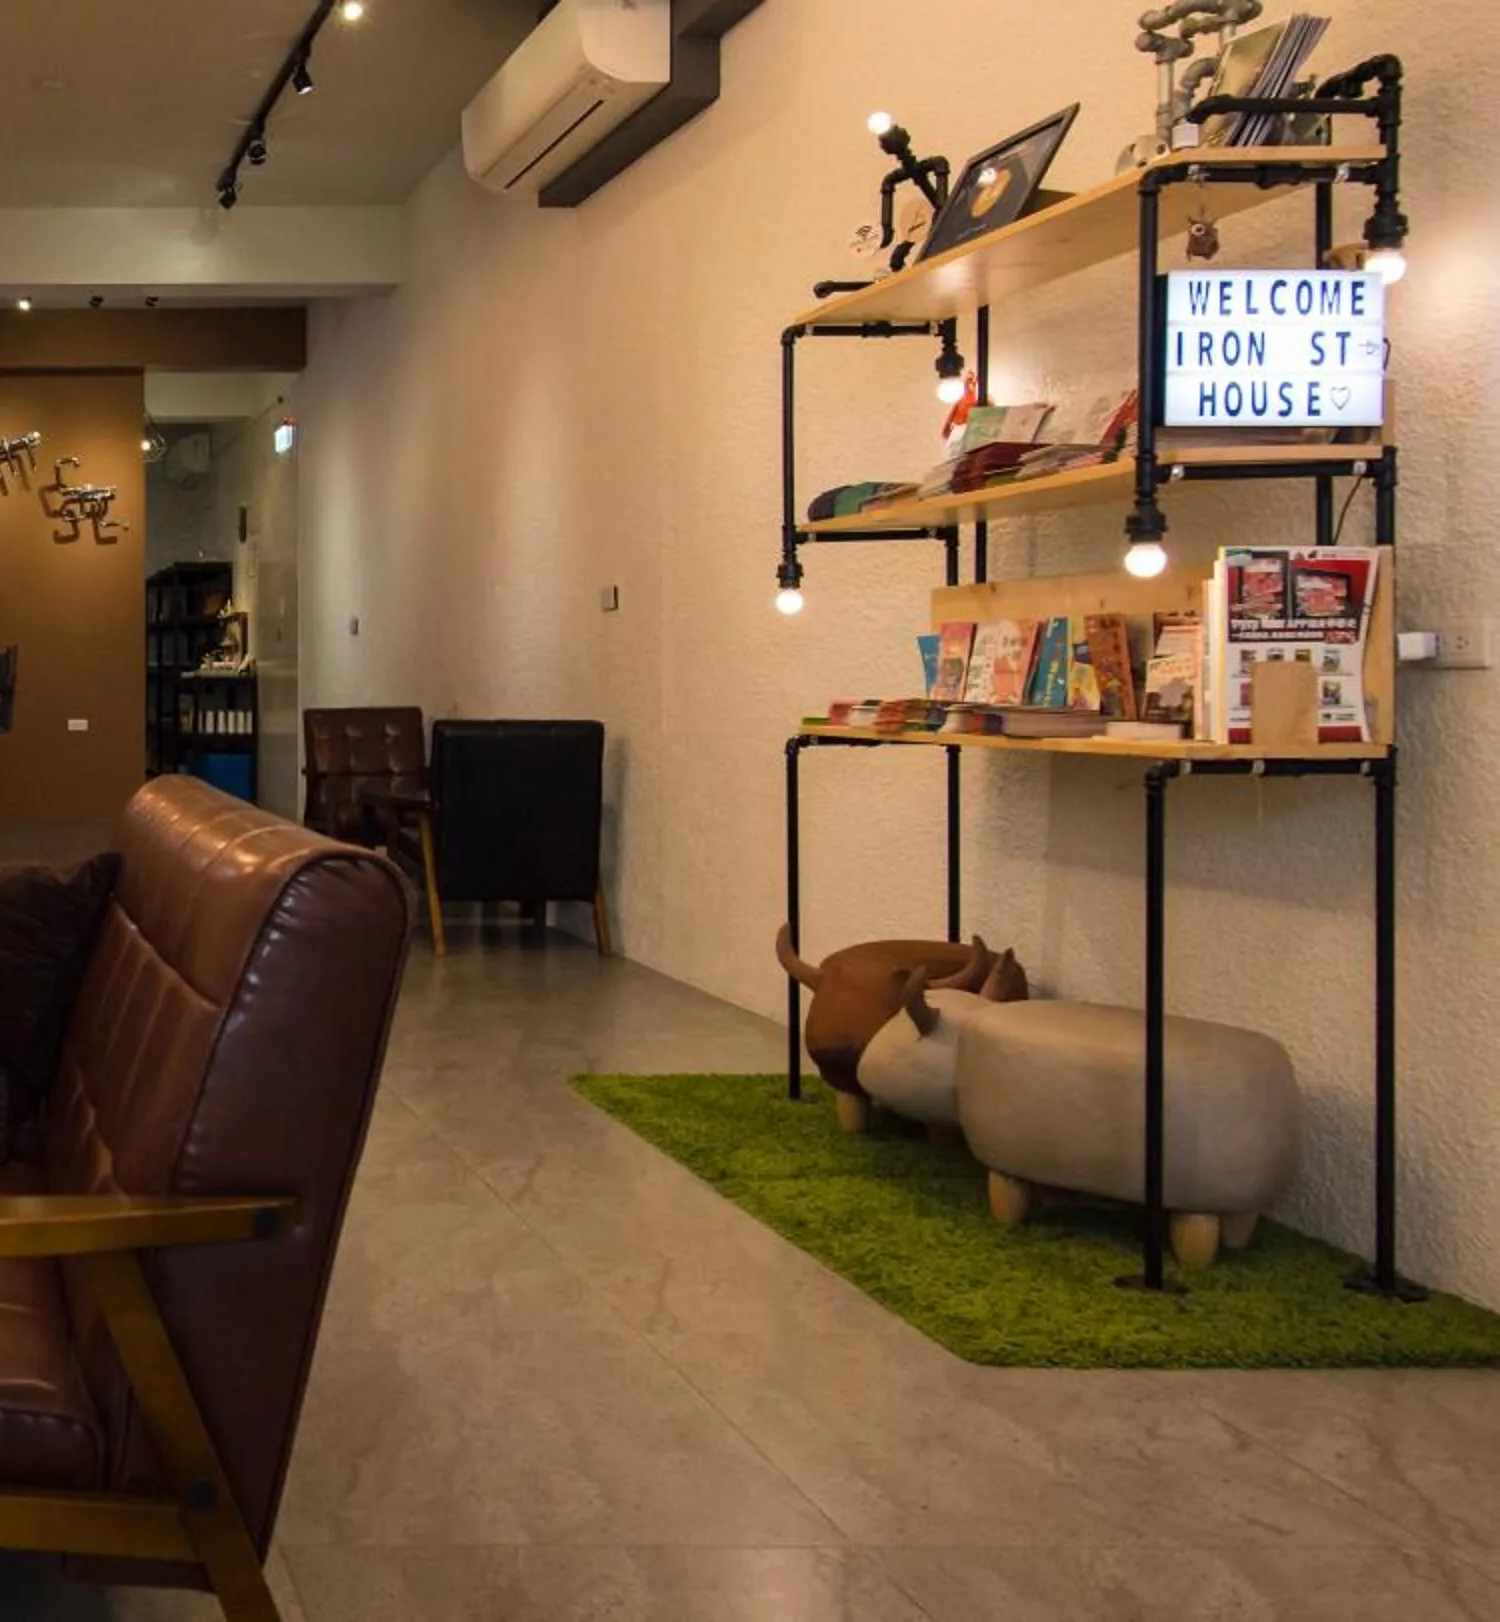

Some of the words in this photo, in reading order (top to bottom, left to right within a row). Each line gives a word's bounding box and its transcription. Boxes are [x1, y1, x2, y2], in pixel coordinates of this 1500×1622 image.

[1188, 280, 1365, 316] WELCOME
[1176, 331, 1266, 367] IRON
[1310, 331, 1351, 367] ST
[1199, 381, 1322, 417] HOUSE
